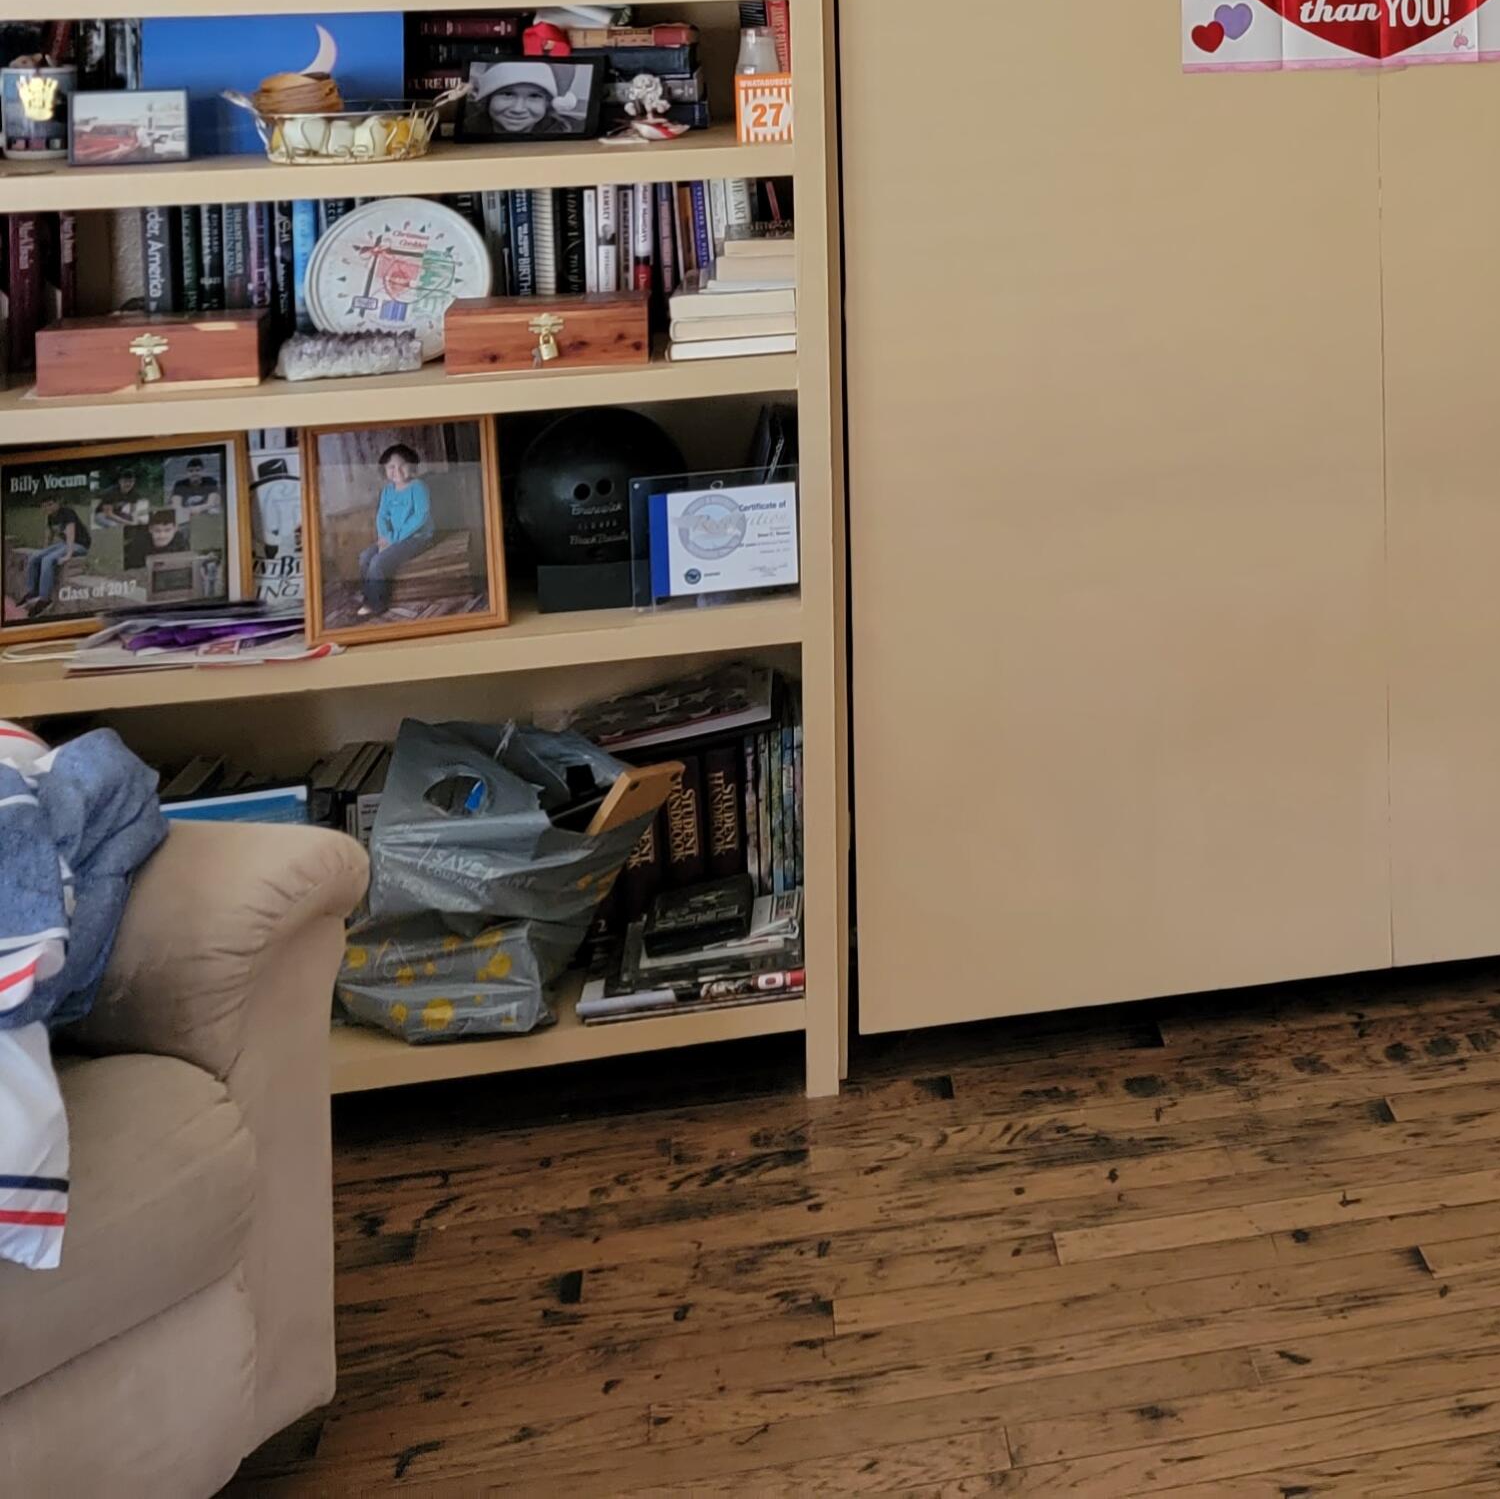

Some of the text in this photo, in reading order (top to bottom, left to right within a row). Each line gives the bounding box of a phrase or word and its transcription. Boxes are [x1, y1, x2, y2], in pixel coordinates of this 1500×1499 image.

[752, 102, 785, 129] 27
[147, 241, 166, 299] America
[10, 474, 87, 494] Billy Yocum
[738, 500, 786, 512] Certificate of
[58, 579, 136, 601] Class of 2017
[682, 788, 699, 858] STUDENT
[708, 771, 725, 856] HANDBOOK
[722, 782, 738, 851] STUDENT
